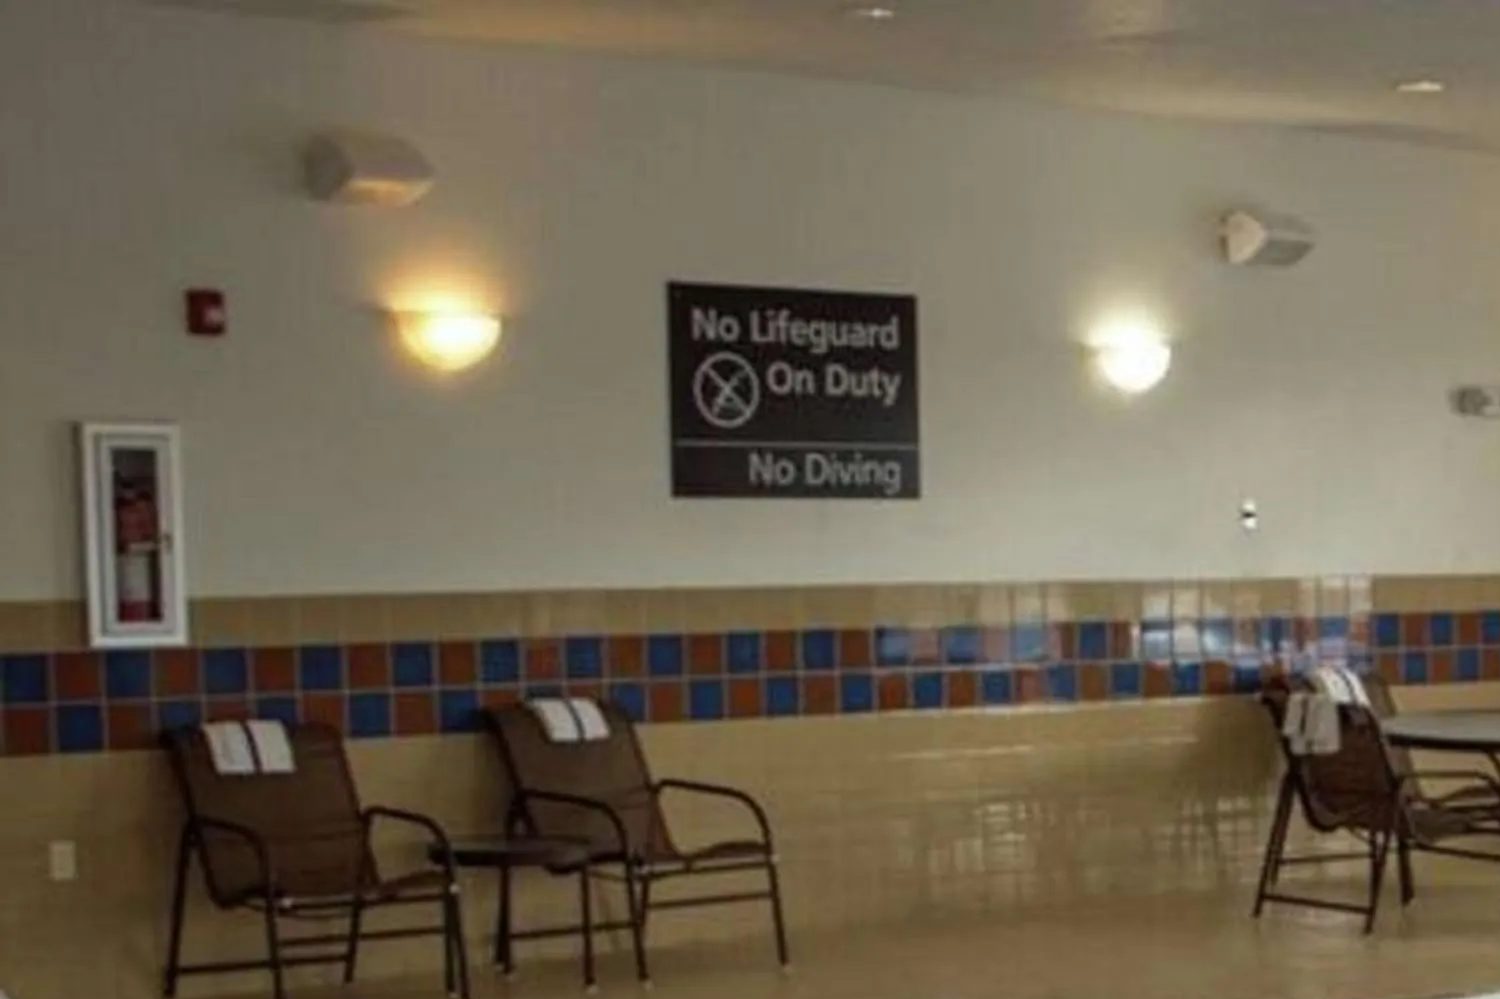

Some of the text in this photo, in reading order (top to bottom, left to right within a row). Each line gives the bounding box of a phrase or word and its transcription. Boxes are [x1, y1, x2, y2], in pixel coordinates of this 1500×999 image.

[690, 306, 900, 354] No Lifeguard
[766, 361, 901, 406] On Duty
[749, 452, 901, 495] No Diving
